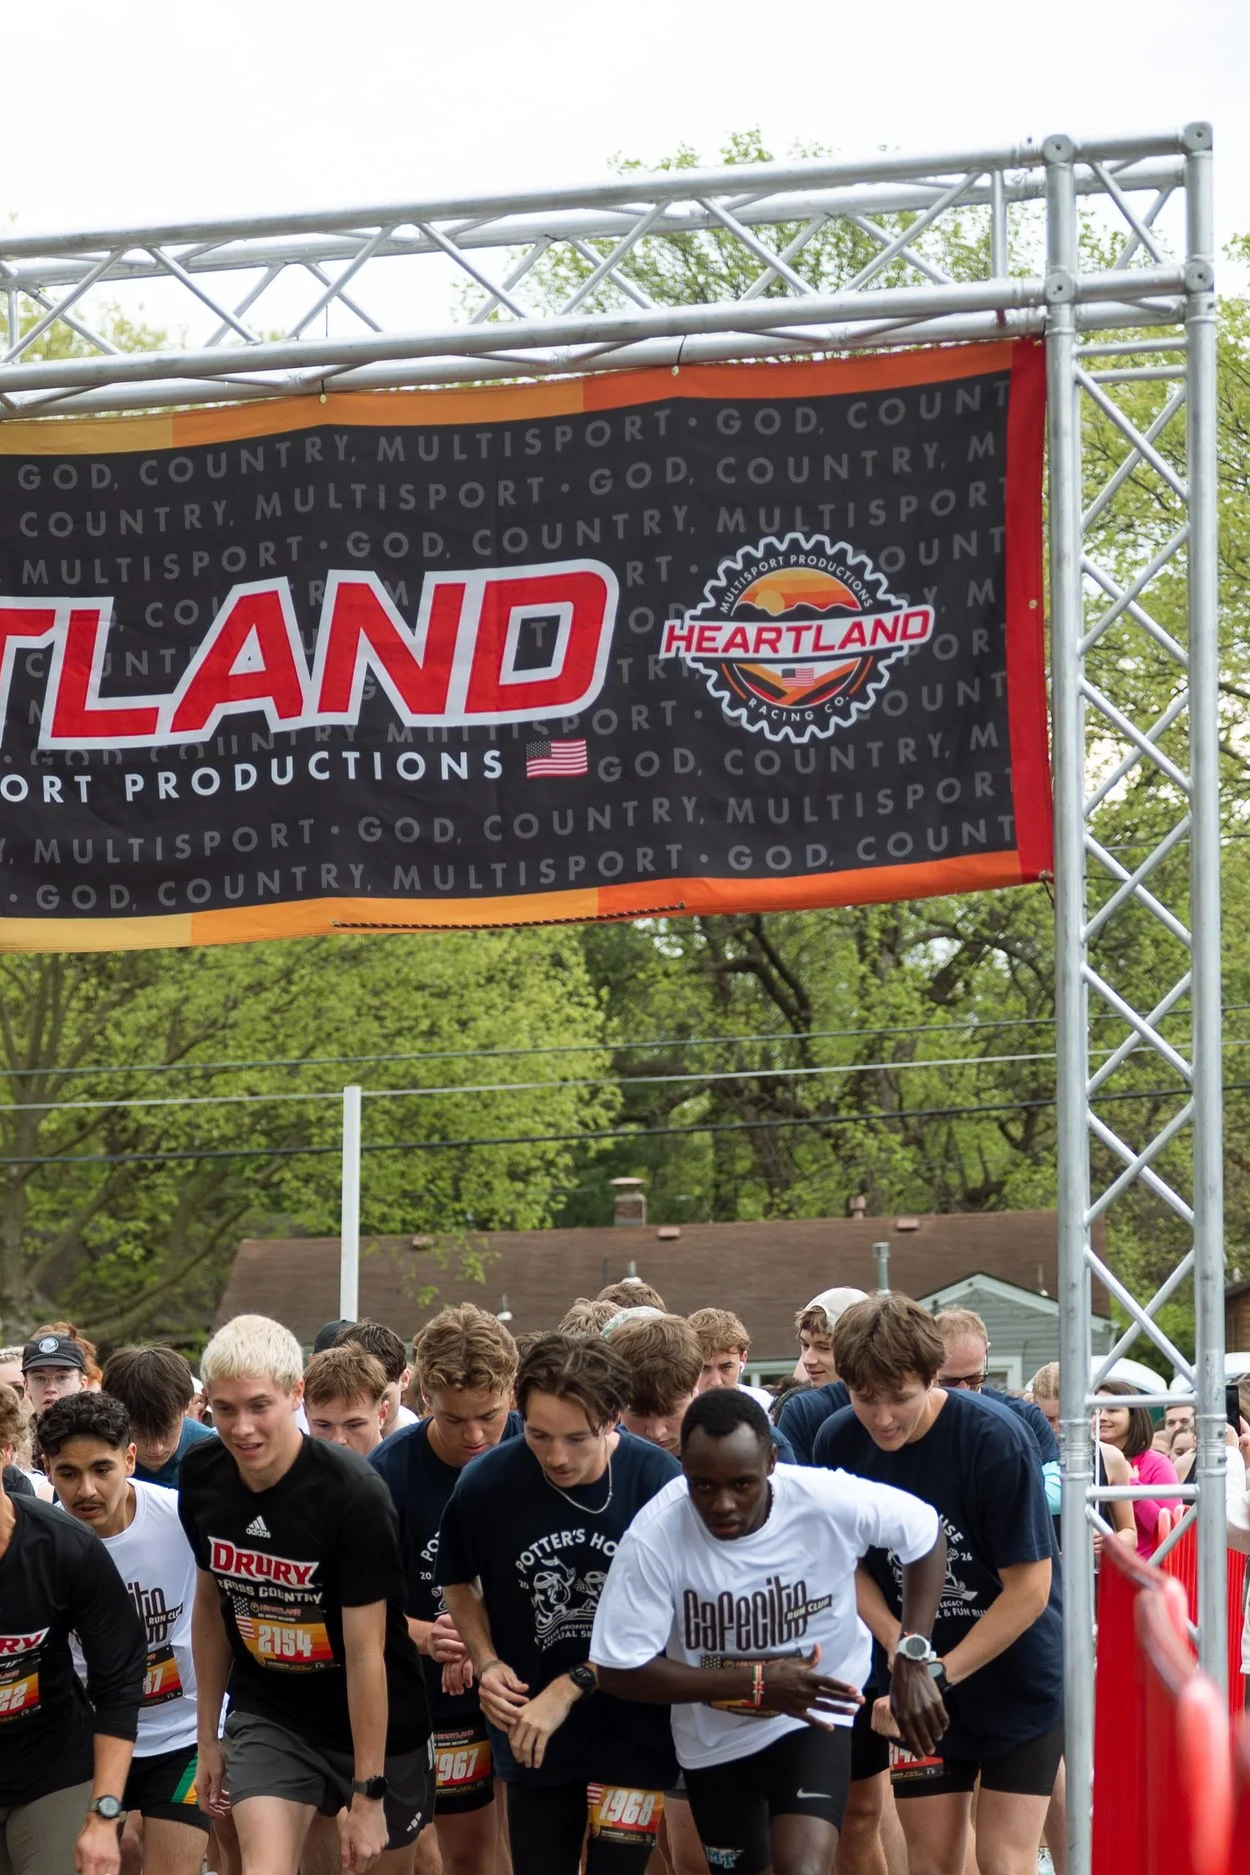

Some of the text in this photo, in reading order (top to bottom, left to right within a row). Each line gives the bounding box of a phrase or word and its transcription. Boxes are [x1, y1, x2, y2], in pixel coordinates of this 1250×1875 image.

[17, 463, 119, 491] GOD,
[139, 434, 357, 485] COUNTRY,
[376, 408, 672, 463] MULTISPORT
[716, 407, 825, 436] GOD,
[19, 499, 235, 538] COUNTRY,
[255, 476, 545, 522] MULTISPORT
[589, 456, 695, 497] GOD,
[716, 441, 947, 484] COUNTRY,
[22, 535, 304, 585] MULTISPORT
[346, 530, 451, 560] GOD,
[472, 504, 696, 557] COUNTRY,
[717, 476, 1006, 534] MULTISPOR
[719, 556, 784, 613] MULTISPORT
[790, 555, 874, 608] PRODUCTIONS
[662, 608, 933, 656] HEARTLAND
[748, 696, 849, 722] RACING CO.
[125, 751, 503, 803] PRODUCTIONS
[598, 748, 702, 783] GOD,
[724, 733, 950, 775] COUNTRY,
[34, 818, 315, 865] MULTISPORT
[358, 815, 462, 846] GOD,
[483, 797, 705, 842] COUNTRY,
[726, 768, 1013, 825] MULTISPOR
[36, 883, 138, 911] GOD,
[158, 864, 371, 907] COUNTRY,
[393, 843, 682, 892] MULTISPORT
[728, 844, 834, 872] GOD,
[246, 1528, 271, 1539] adidas
[515, 1528, 586, 1574] POTTER'S
[207, 1536, 320, 1590] DRURY
[420, 1571, 432, 1580] 20
[961, 1552, 973, 1561] 26
[259, 1587, 323, 1605] COUNTRY
[786, 1597, 831, 1620] RUN CLUB
[939, 1600, 963, 1609] LEGACY
[952, 1607, 971, 1616] FUN
[149, 1614, 166, 1625] RUN
[258, 1625, 312, 1657] 2154
[600, 1789, 655, 1826] 1968
